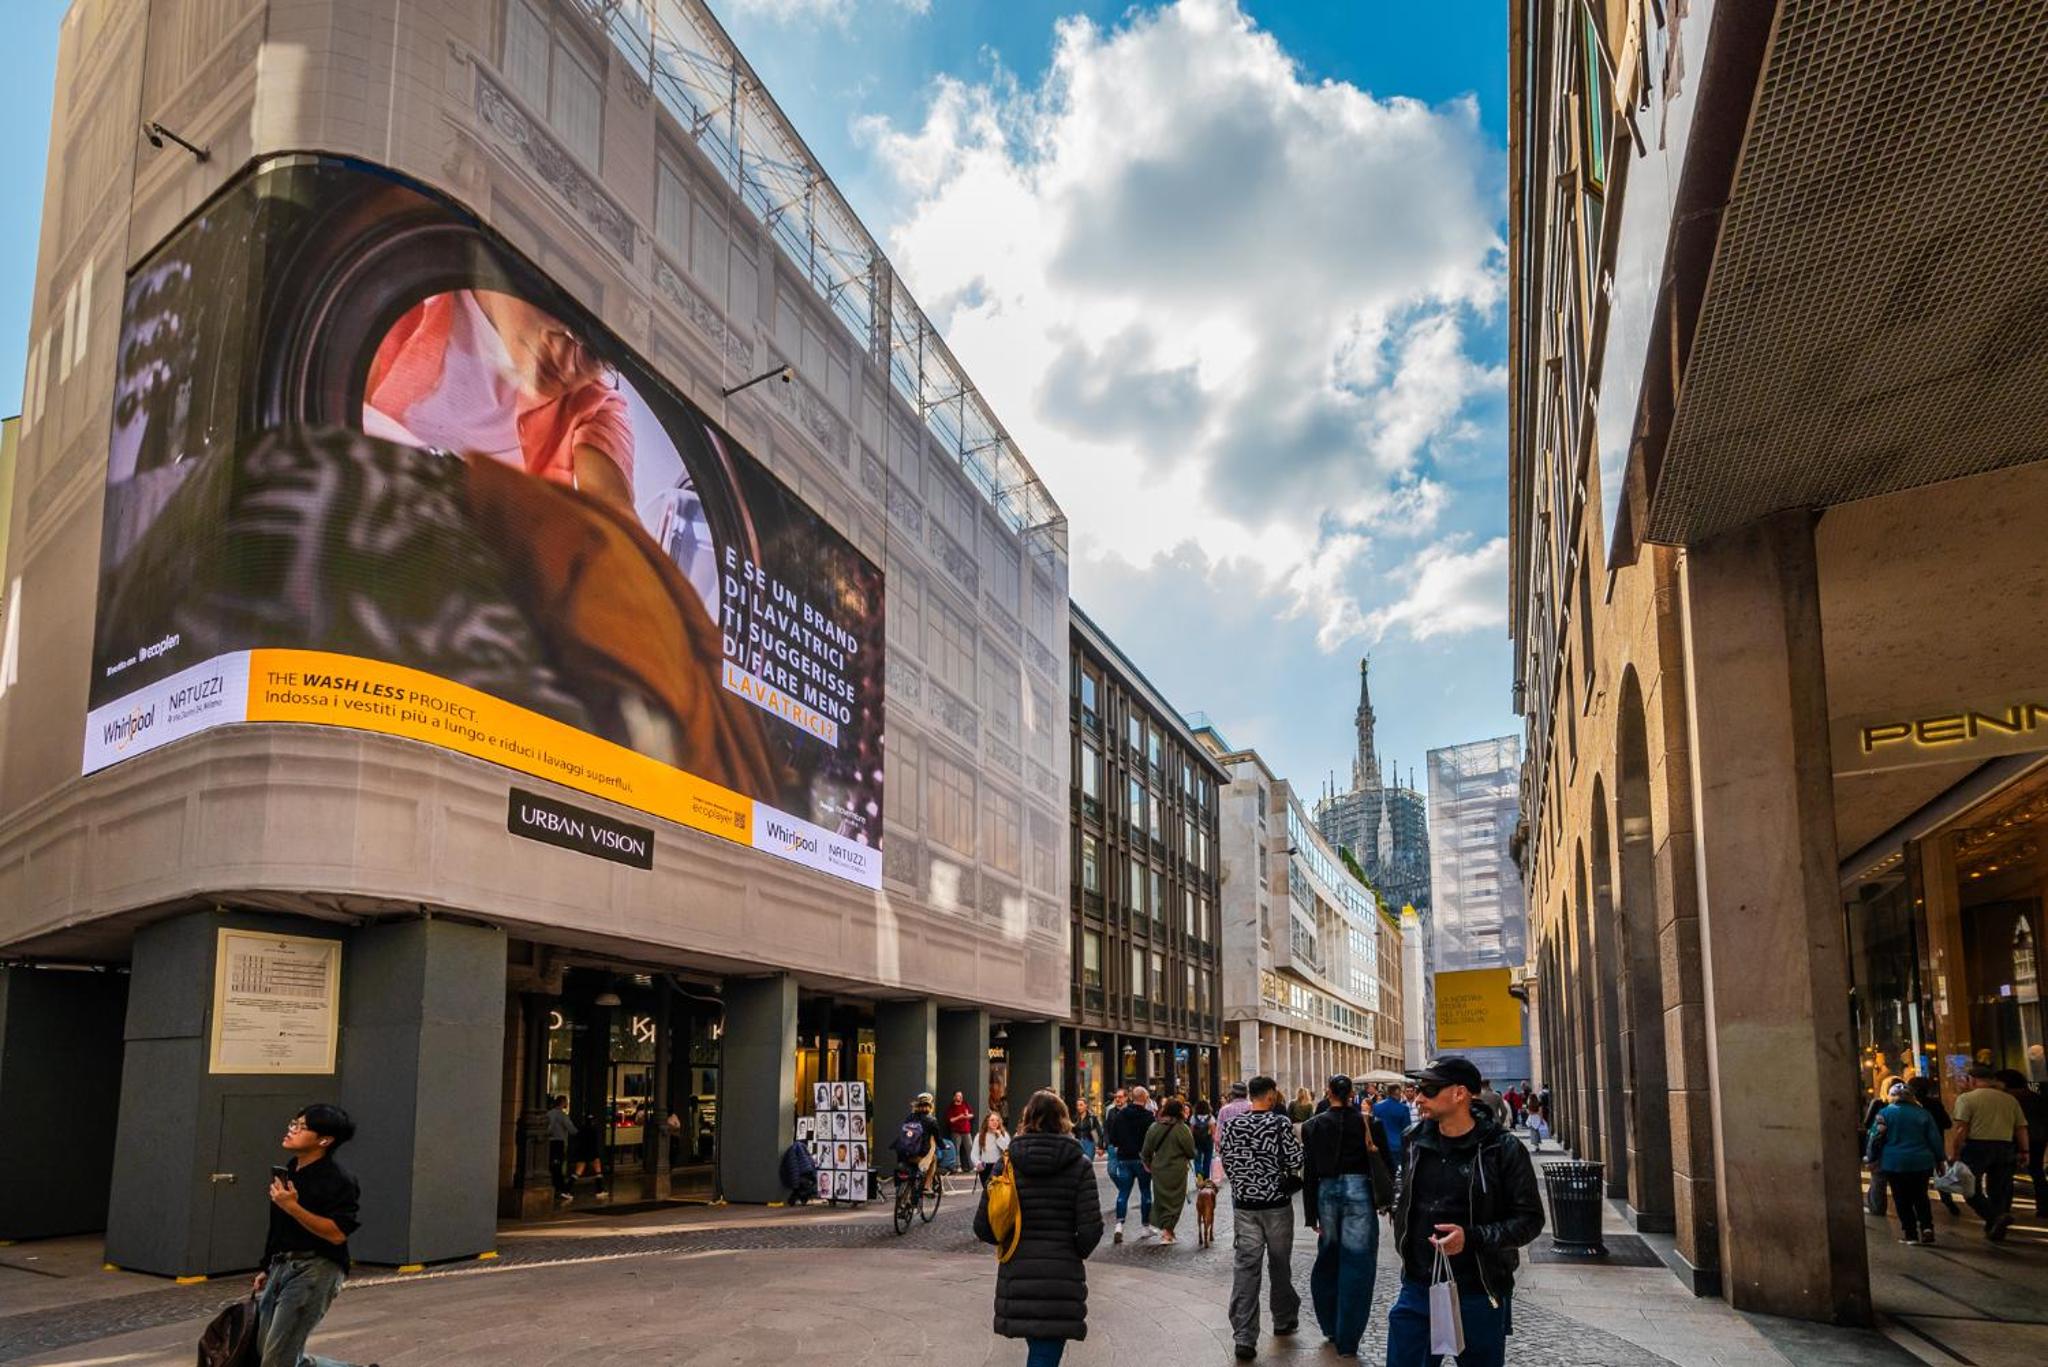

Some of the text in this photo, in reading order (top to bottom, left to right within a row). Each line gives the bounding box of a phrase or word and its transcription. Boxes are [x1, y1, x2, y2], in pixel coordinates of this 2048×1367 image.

[725, 575, 844, 671] DI LAVATRICI
[726, 545, 859, 655] E SE UN BRAND
[723, 605, 855, 704] TI SUGGERISSE
[723, 634, 851, 725] DI FARE MENO
[103, 703, 155, 746] Whirlpool
[169, 675, 224, 712] NATUZZI
[267, 672, 479, 724] THE WASH LESS PROJECT.
[727, 667, 834, 741] LAVATRICI?
[265, 690, 328, 706] Indossa
[334, 695, 338, 707] i
[343, 698, 397, 717] vestiti
[400, 707, 427, 724] più
[431, 717, 440, 728] a
[444, 716, 485, 742] lungo
[488, 734, 497, 745] e
[499, 737, 535, 759] riduci
[543, 751, 584, 776] lavaggi
[586, 768, 633, 793] superflui.
[521, 804, 646, 857] URBAN VISION
[766, 820, 818, 854] Whirlpool
[828, 844, 867, 867] NATUZZI
